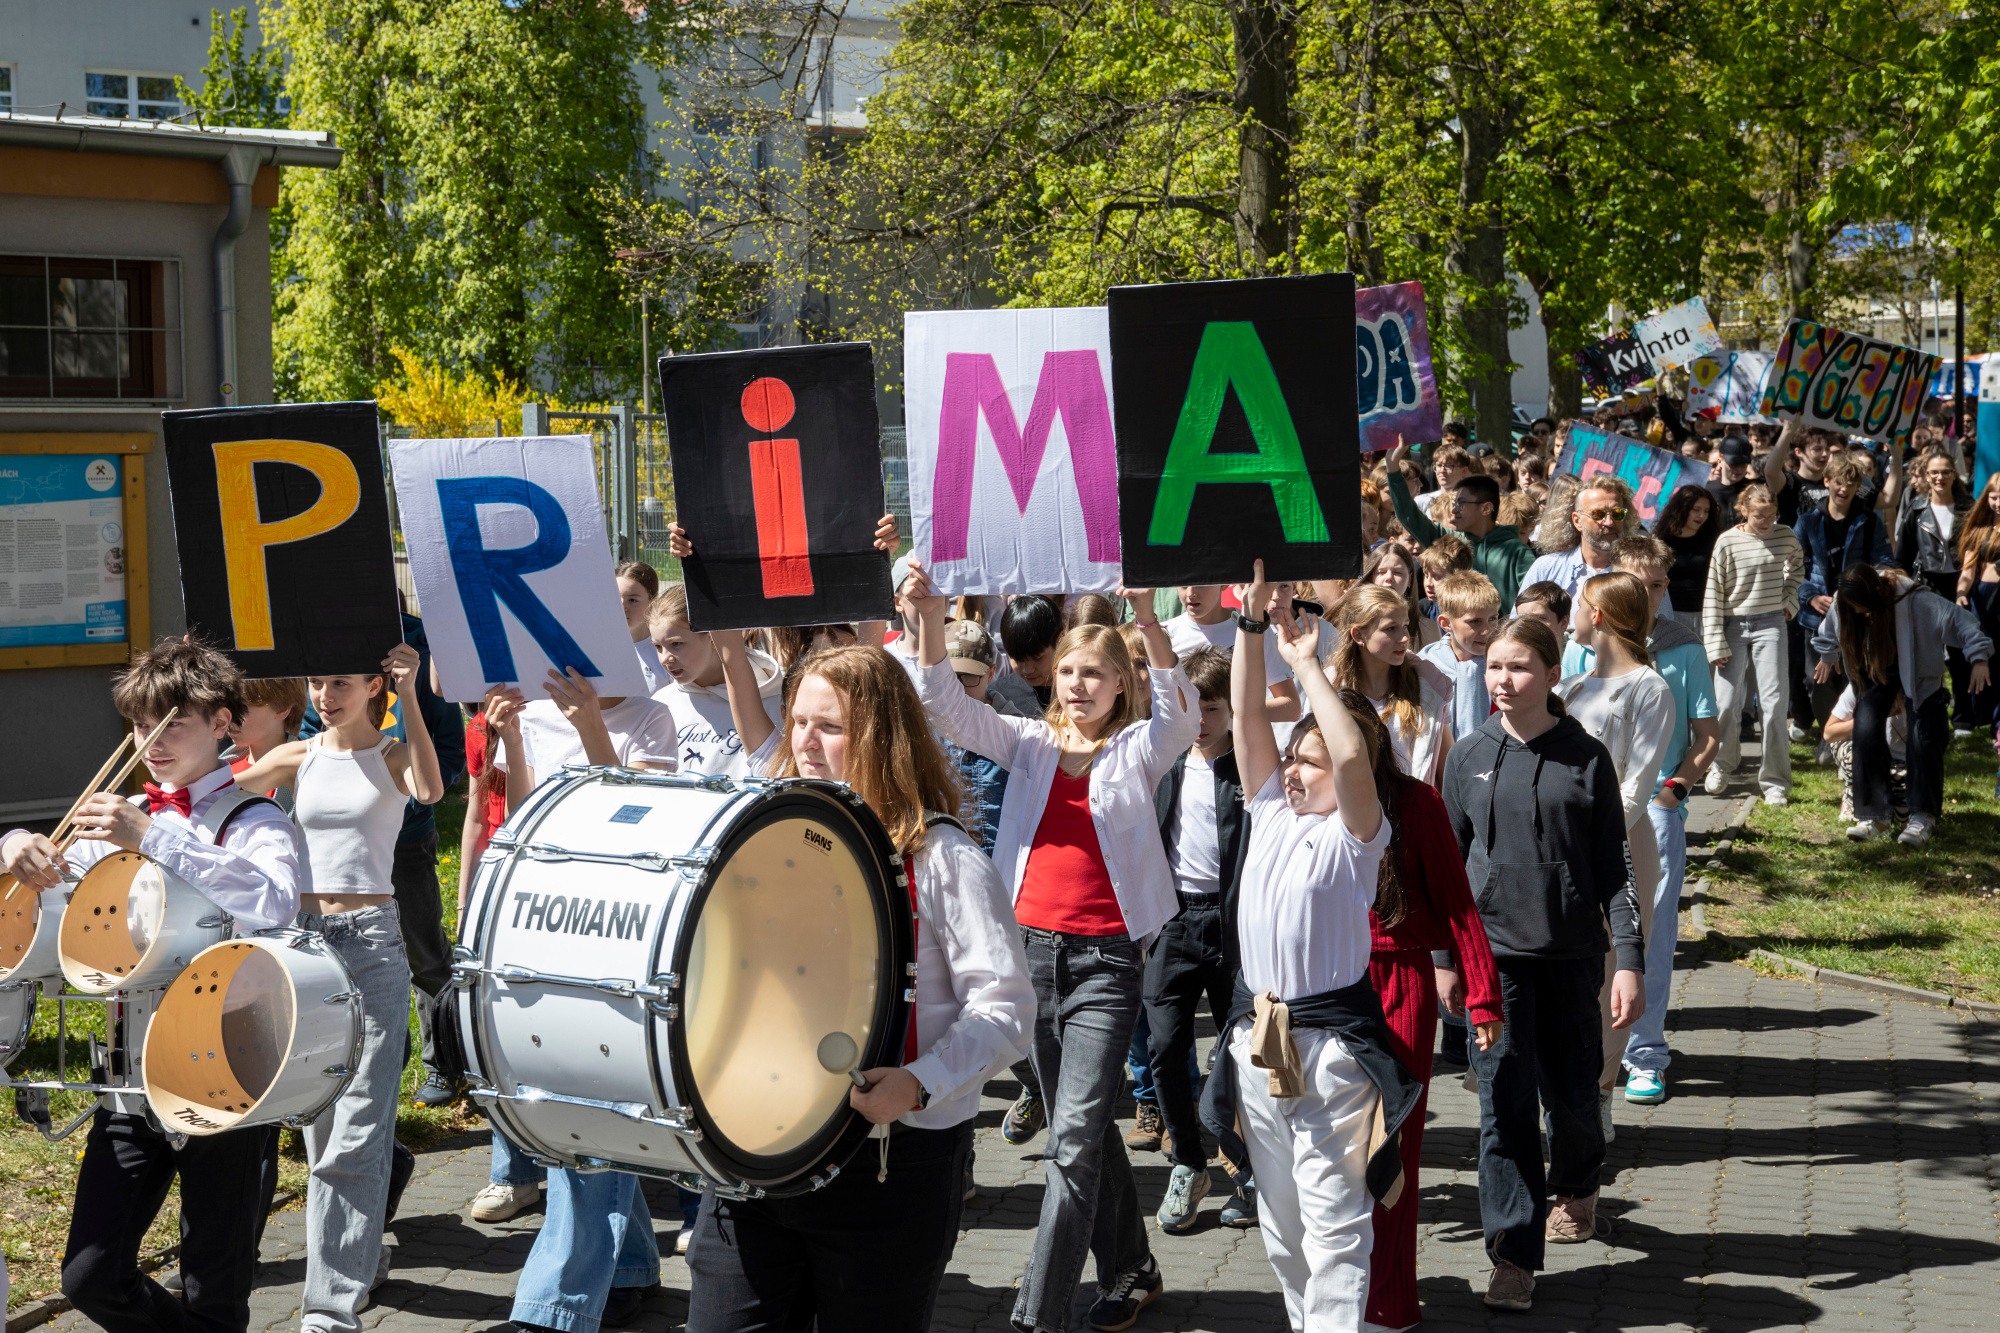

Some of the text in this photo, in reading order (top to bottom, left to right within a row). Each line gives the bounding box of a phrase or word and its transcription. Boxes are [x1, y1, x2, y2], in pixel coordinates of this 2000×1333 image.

[1607, 326, 1691, 376] Kvinta
[677, 722, 712, 748] Just
[711, 734, 723, 744] a
[804, 828, 833, 851] EVANS
[511, 891, 652, 942] THOMANN
